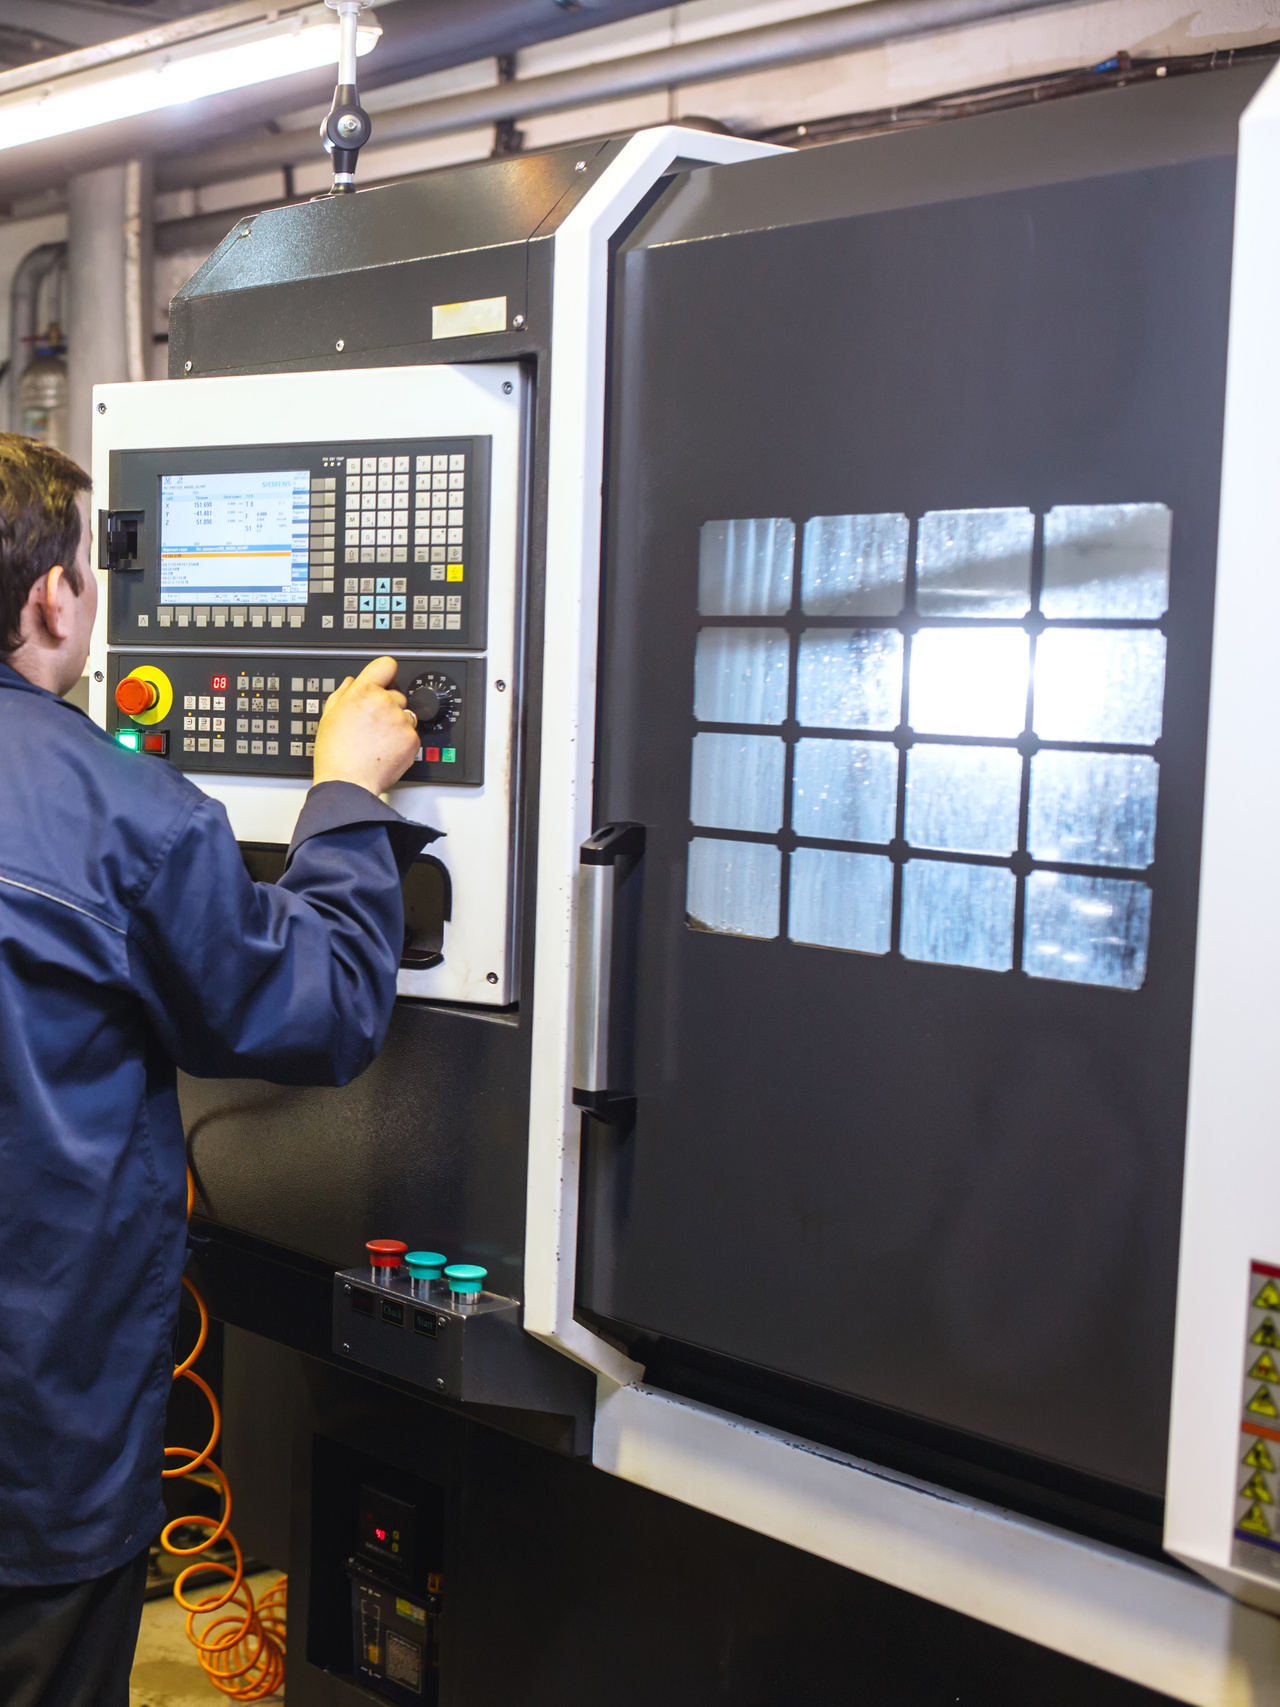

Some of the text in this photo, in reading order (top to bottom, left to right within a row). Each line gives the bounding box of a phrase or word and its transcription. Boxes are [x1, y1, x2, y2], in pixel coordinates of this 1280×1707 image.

[213, 677, 226, 689] 08
[383, 1305, 402, 1319] Chuck
[417, 1316, 433, 1330] Start
